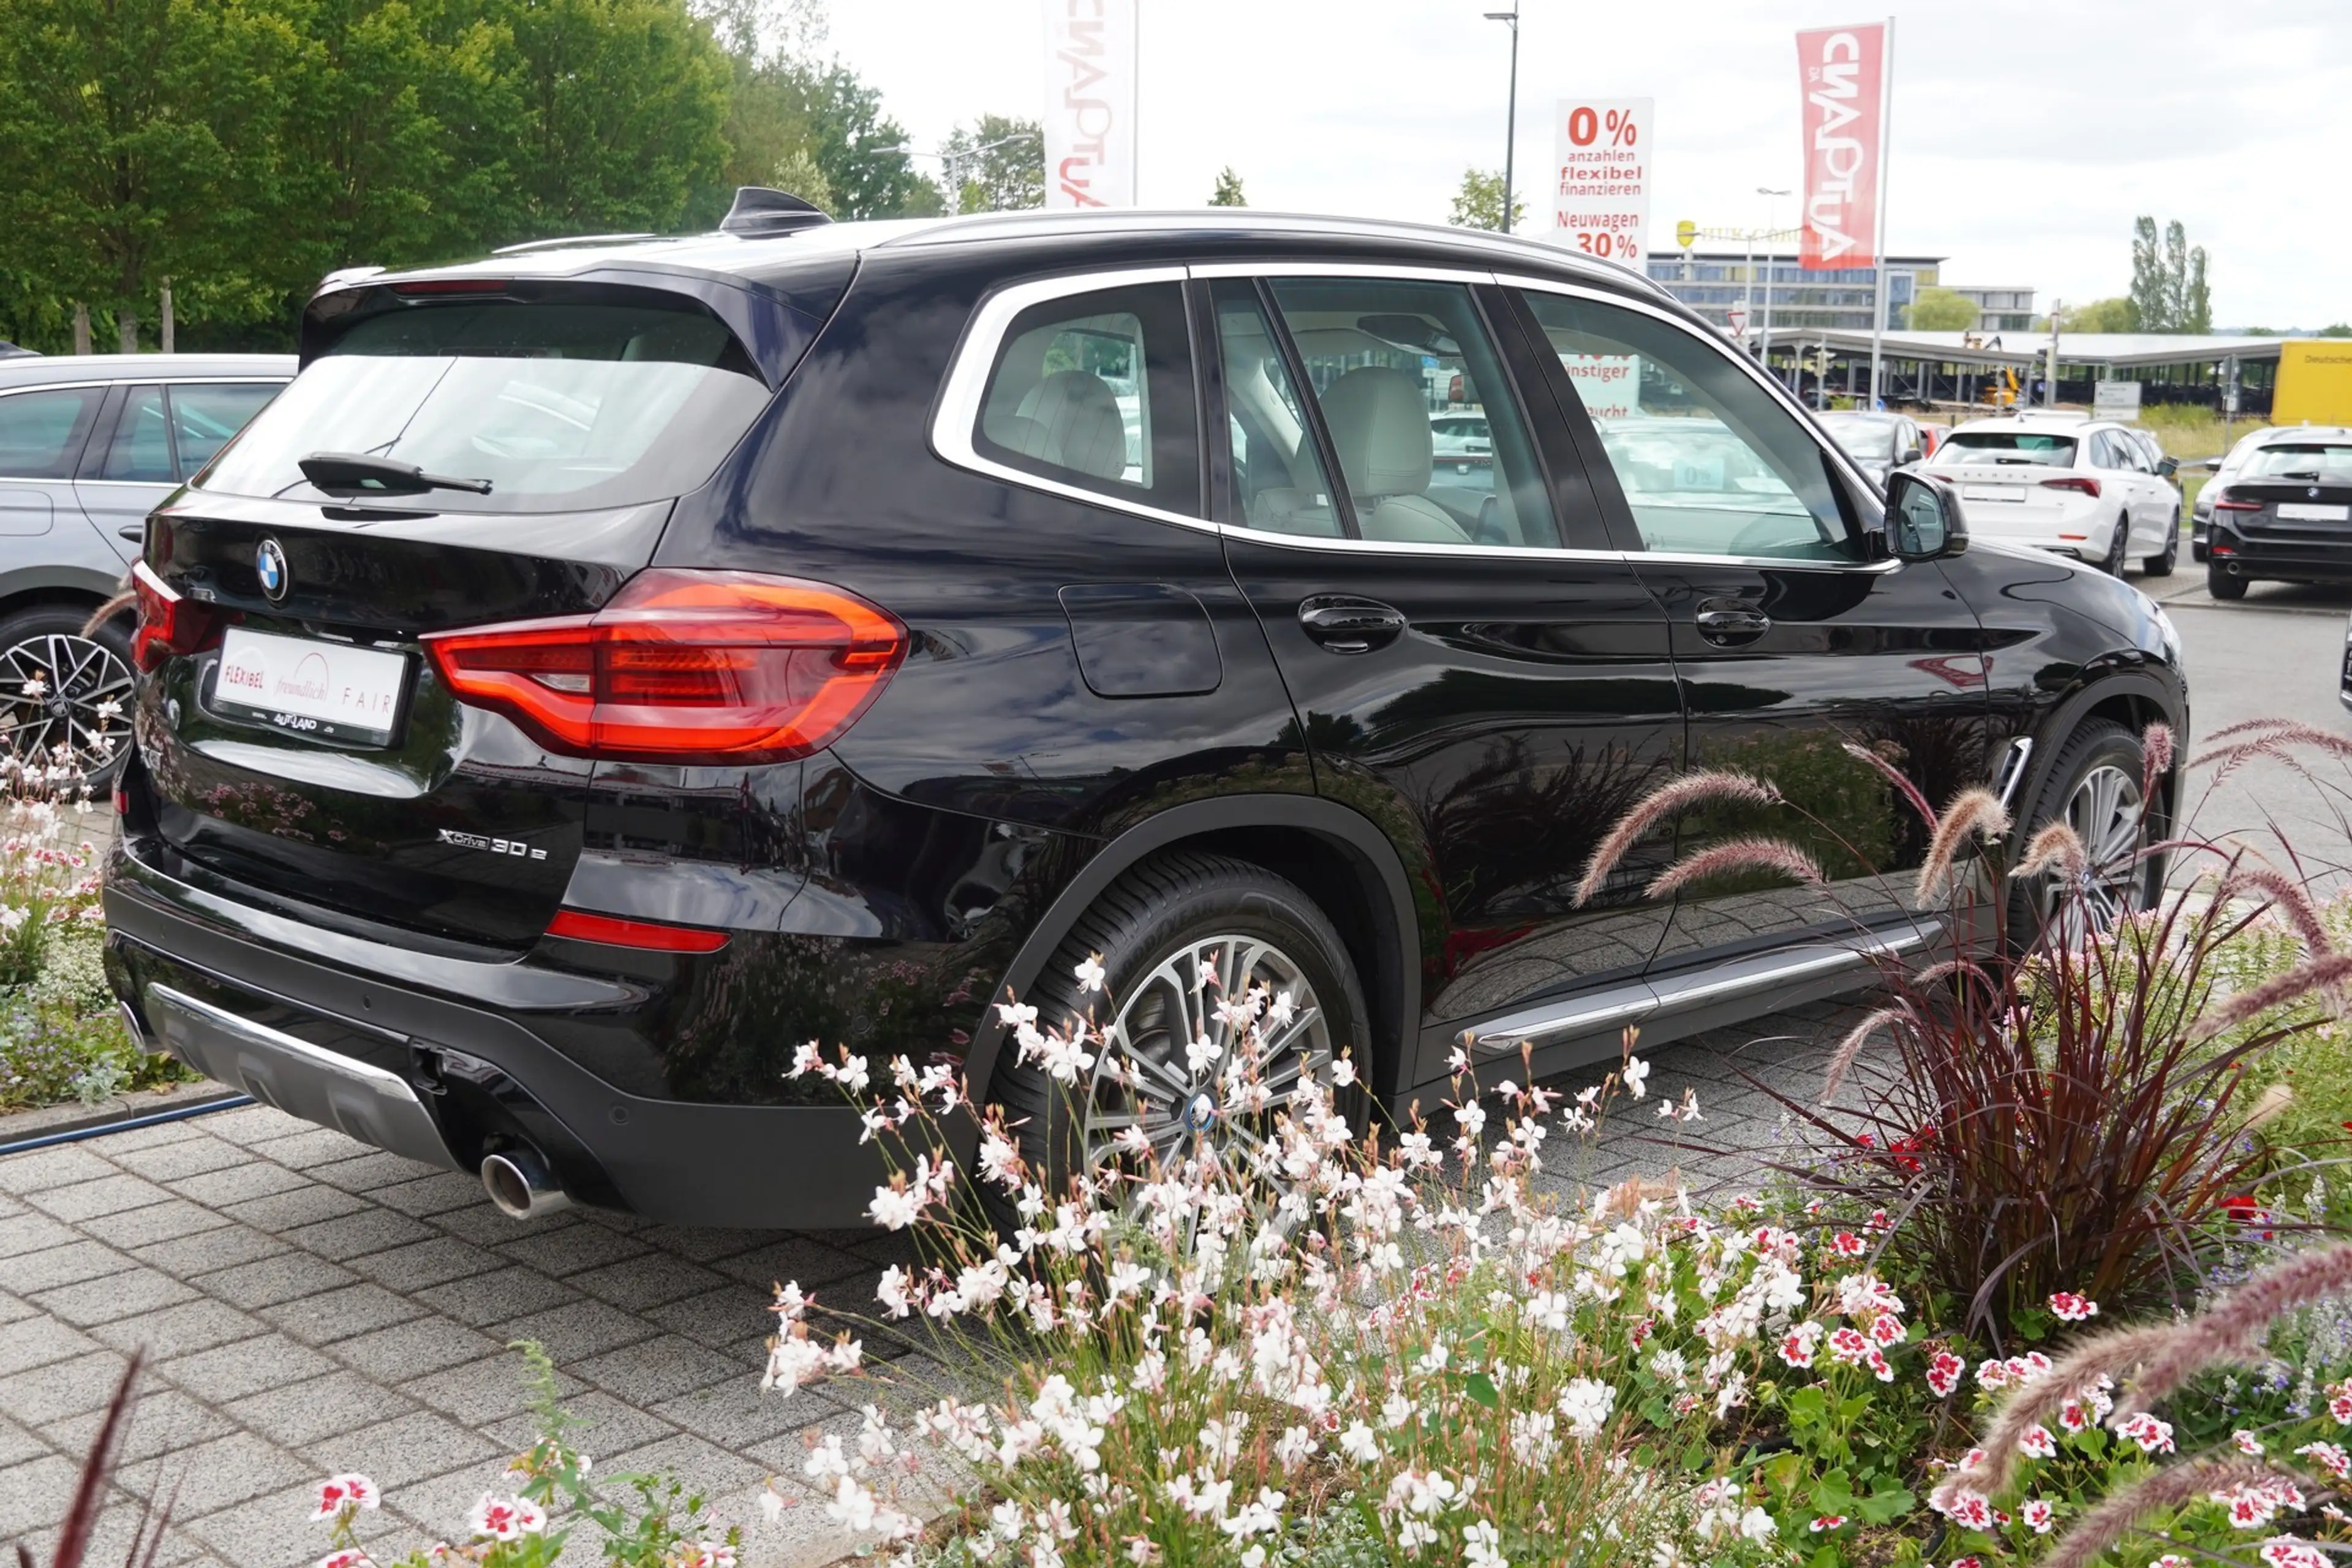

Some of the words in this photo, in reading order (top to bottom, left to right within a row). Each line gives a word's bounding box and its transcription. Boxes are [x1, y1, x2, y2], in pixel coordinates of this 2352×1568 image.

[1568, 107, 1598, 146] 0
[1605, 109, 1637, 146] %
[1567, 149, 1635, 162] anzahlen
[1561, 166, 1642, 180] flexibel
[1559, 182, 1642, 196] finanzieren
[1557, 211, 1638, 233] Neuwagen
[1577, 232, 1611, 257] 30
[1617, 235, 1637, 258] %
[225, 665, 263, 689] FLEXIBEL
[274, 713, 317, 731] AUTOLAND
